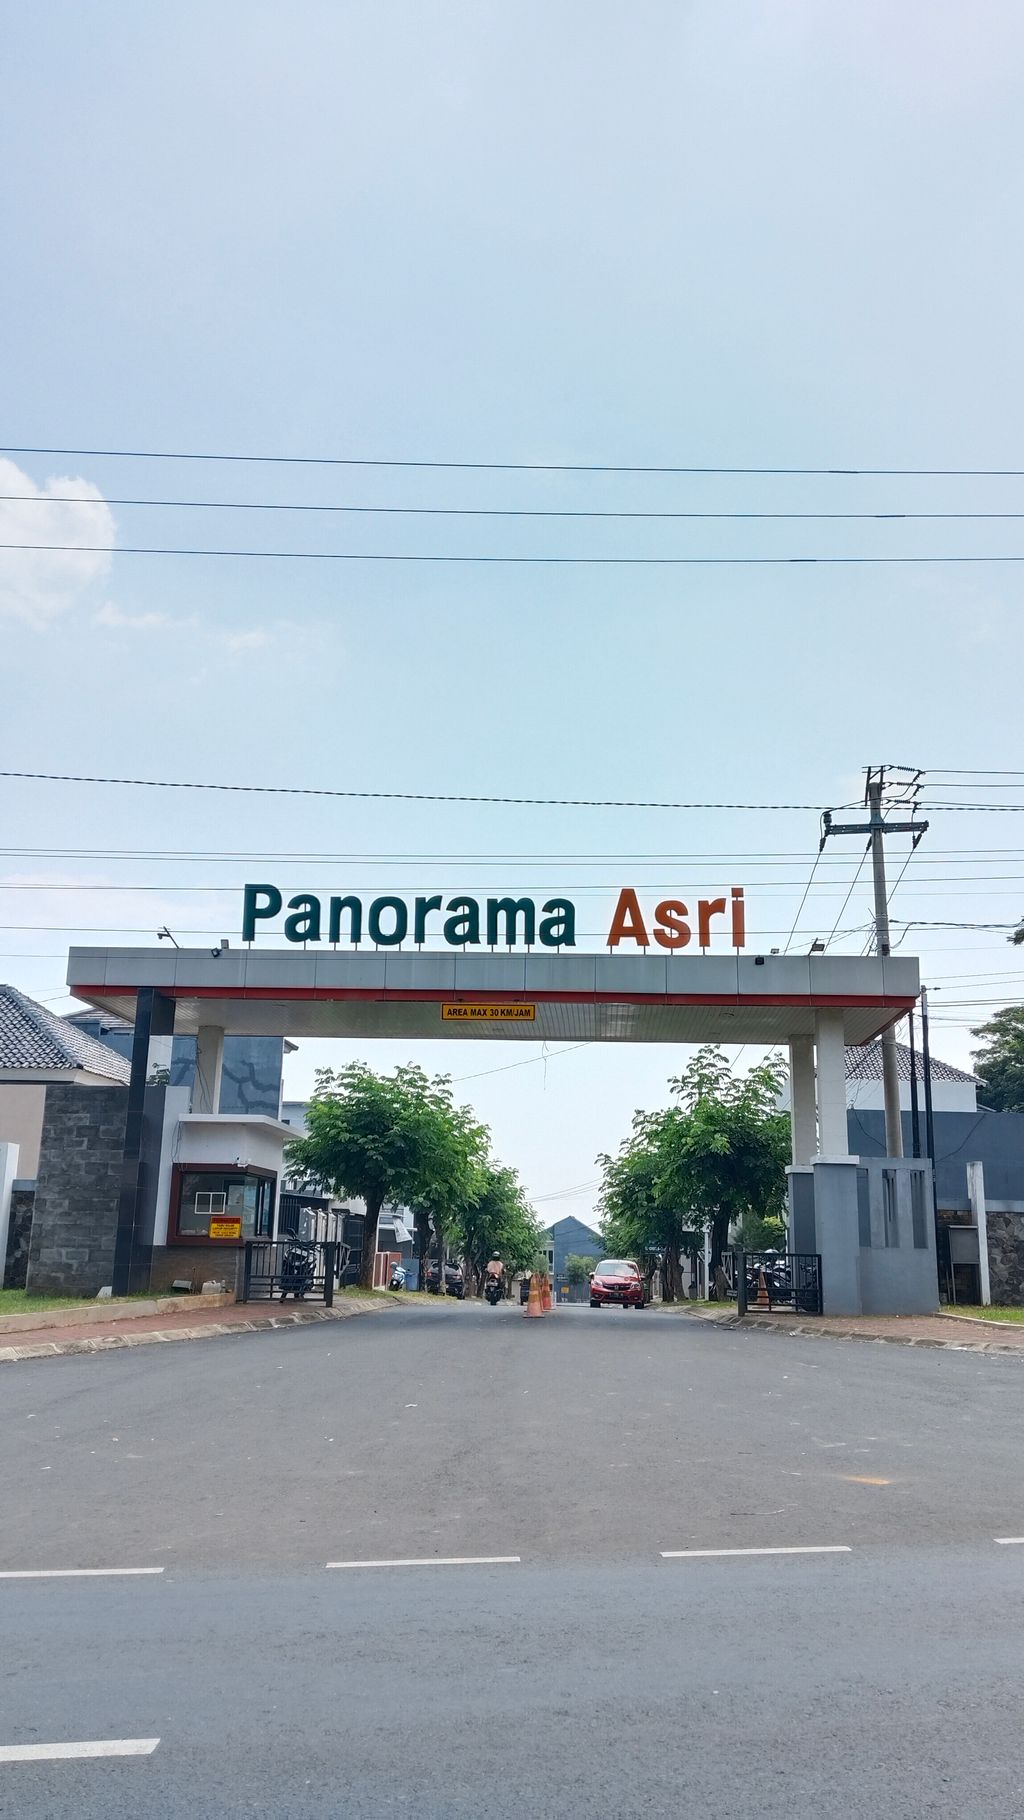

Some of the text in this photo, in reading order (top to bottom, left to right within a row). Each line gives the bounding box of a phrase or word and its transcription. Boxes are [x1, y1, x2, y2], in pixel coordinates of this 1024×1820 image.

[242, 883, 745, 949] Panorama Asri
[447, 1008, 531, 1017] AREA MAX 30 KM/JAM
